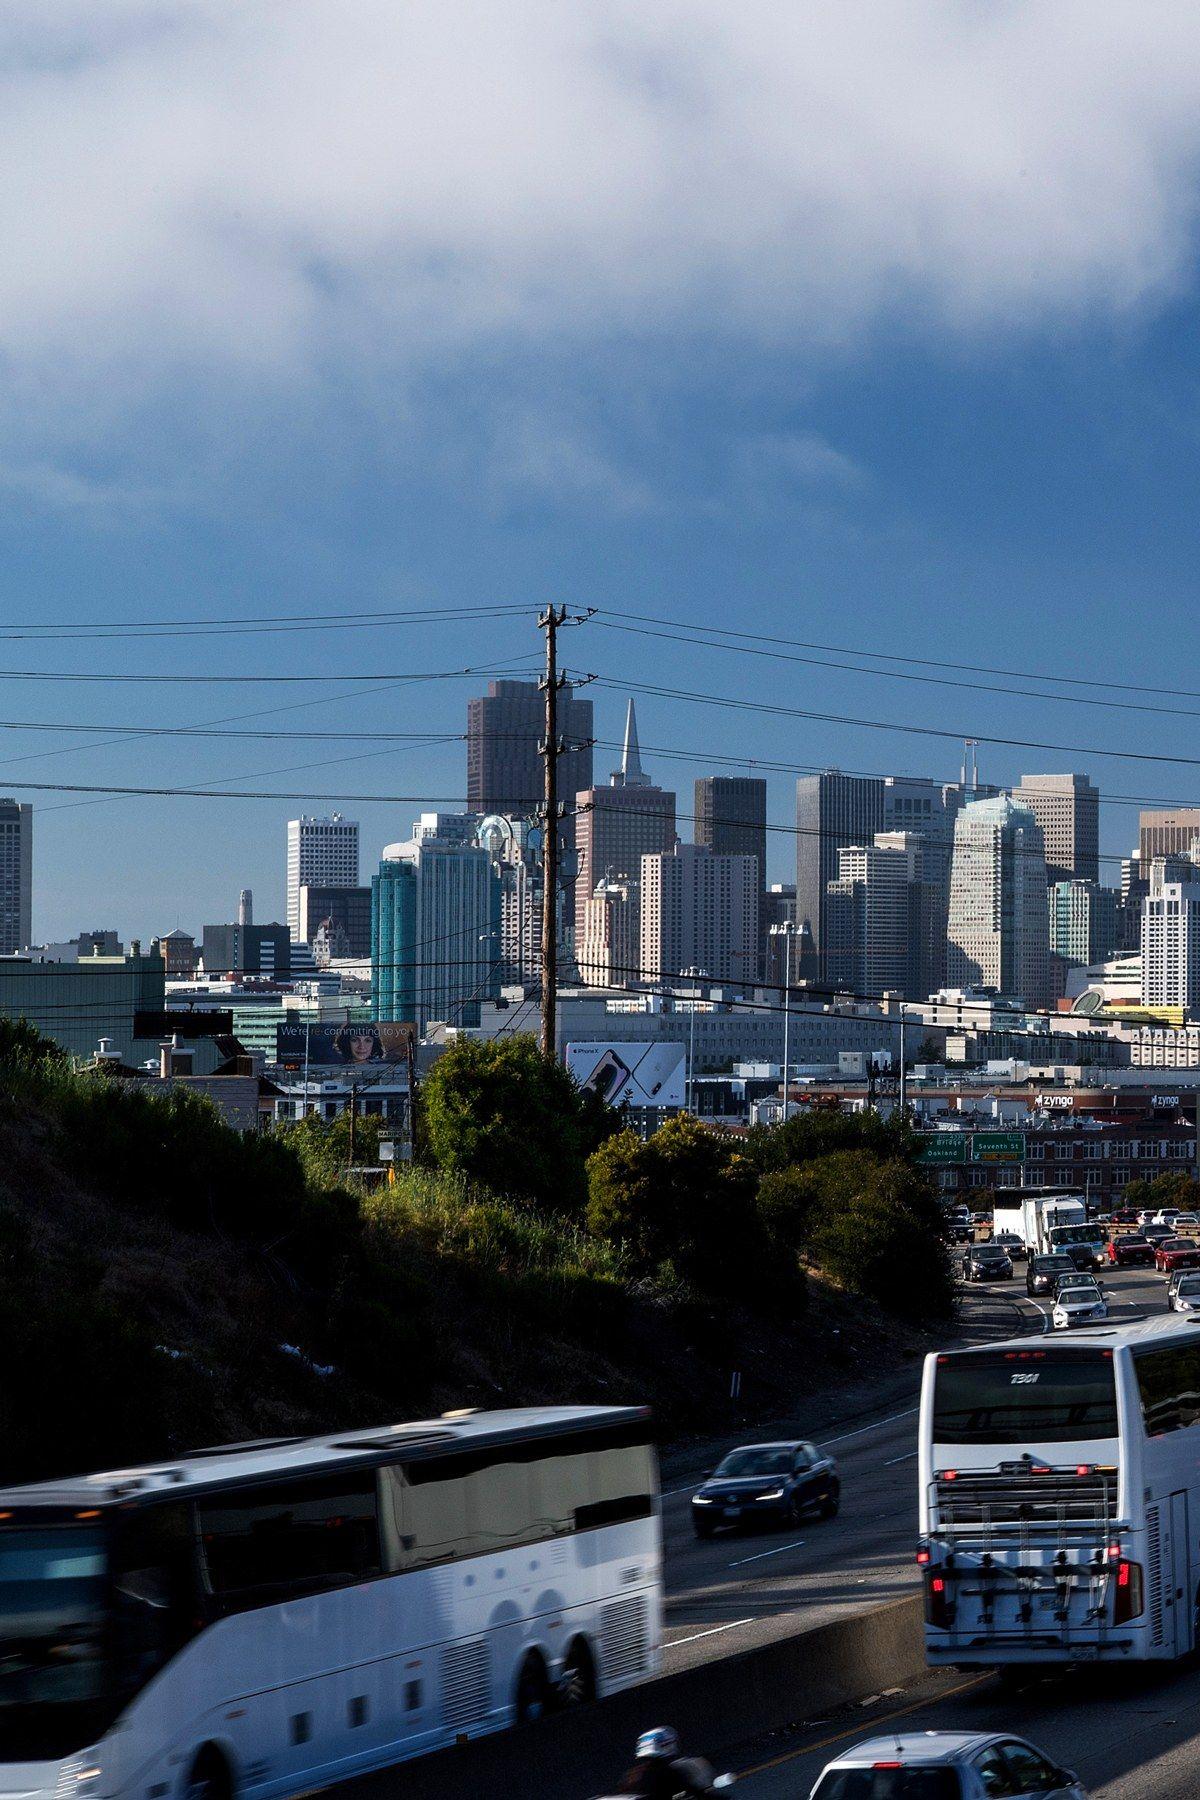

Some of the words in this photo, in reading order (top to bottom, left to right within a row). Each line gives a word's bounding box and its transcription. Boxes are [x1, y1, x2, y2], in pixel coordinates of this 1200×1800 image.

[281, 1026, 307, 1036] We're
[324, 1026, 380, 1038] committing
[383, 1027, 394, 1036] to
[1043, 1096, 1073, 1107] zynga
[1158, 1096, 1179, 1107] zynga
